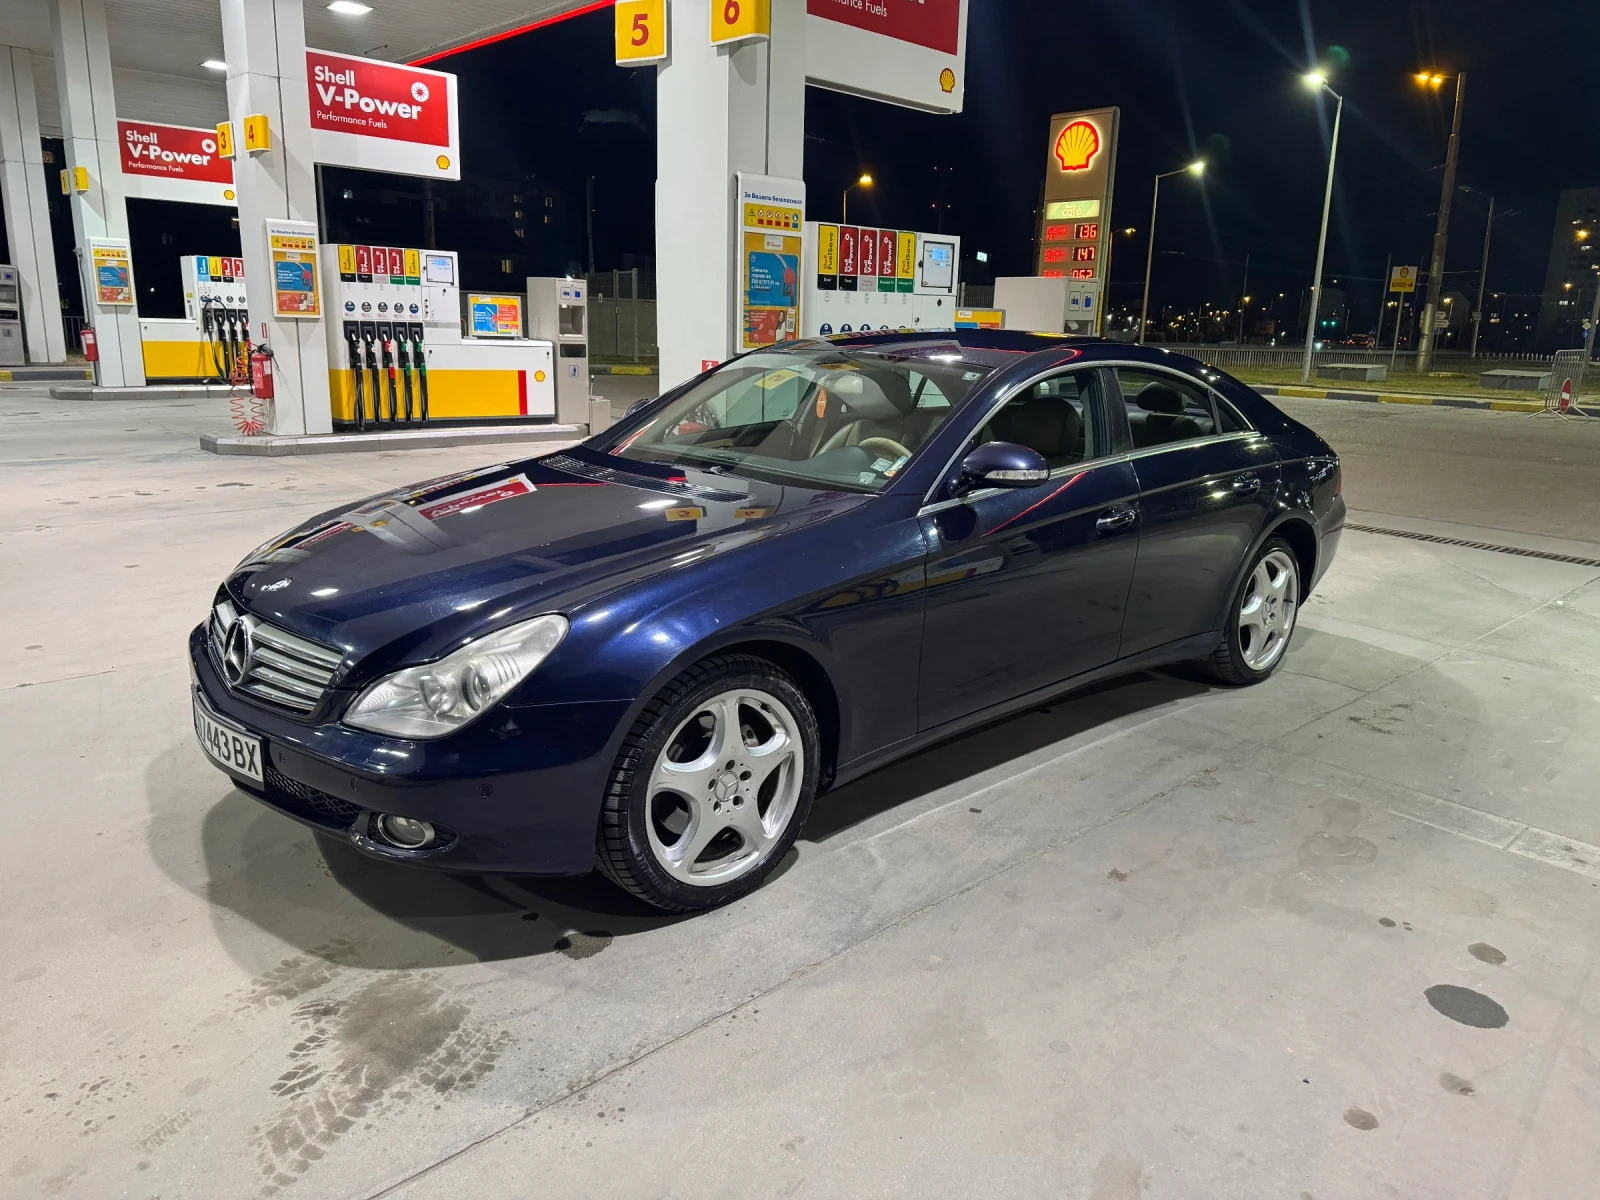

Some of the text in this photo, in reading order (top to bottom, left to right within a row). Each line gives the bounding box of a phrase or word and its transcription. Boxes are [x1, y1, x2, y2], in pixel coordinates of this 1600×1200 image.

[724, 0, 740, 25] 6
[865, 0, 887, 17] Fuels
[631, 13, 649, 47] 5
[314, 65, 356, 87] Shell
[315, 83, 422, 120] V-Power
[316, 110, 388, 129] Performance Fuels
[125, 130, 158, 144] Shell
[221, 131, 227, 150] 3
[248, 124, 255, 143] 4
[127, 142, 210, 166] V-Power
[128, 161, 184, 173] Performance Fuels
